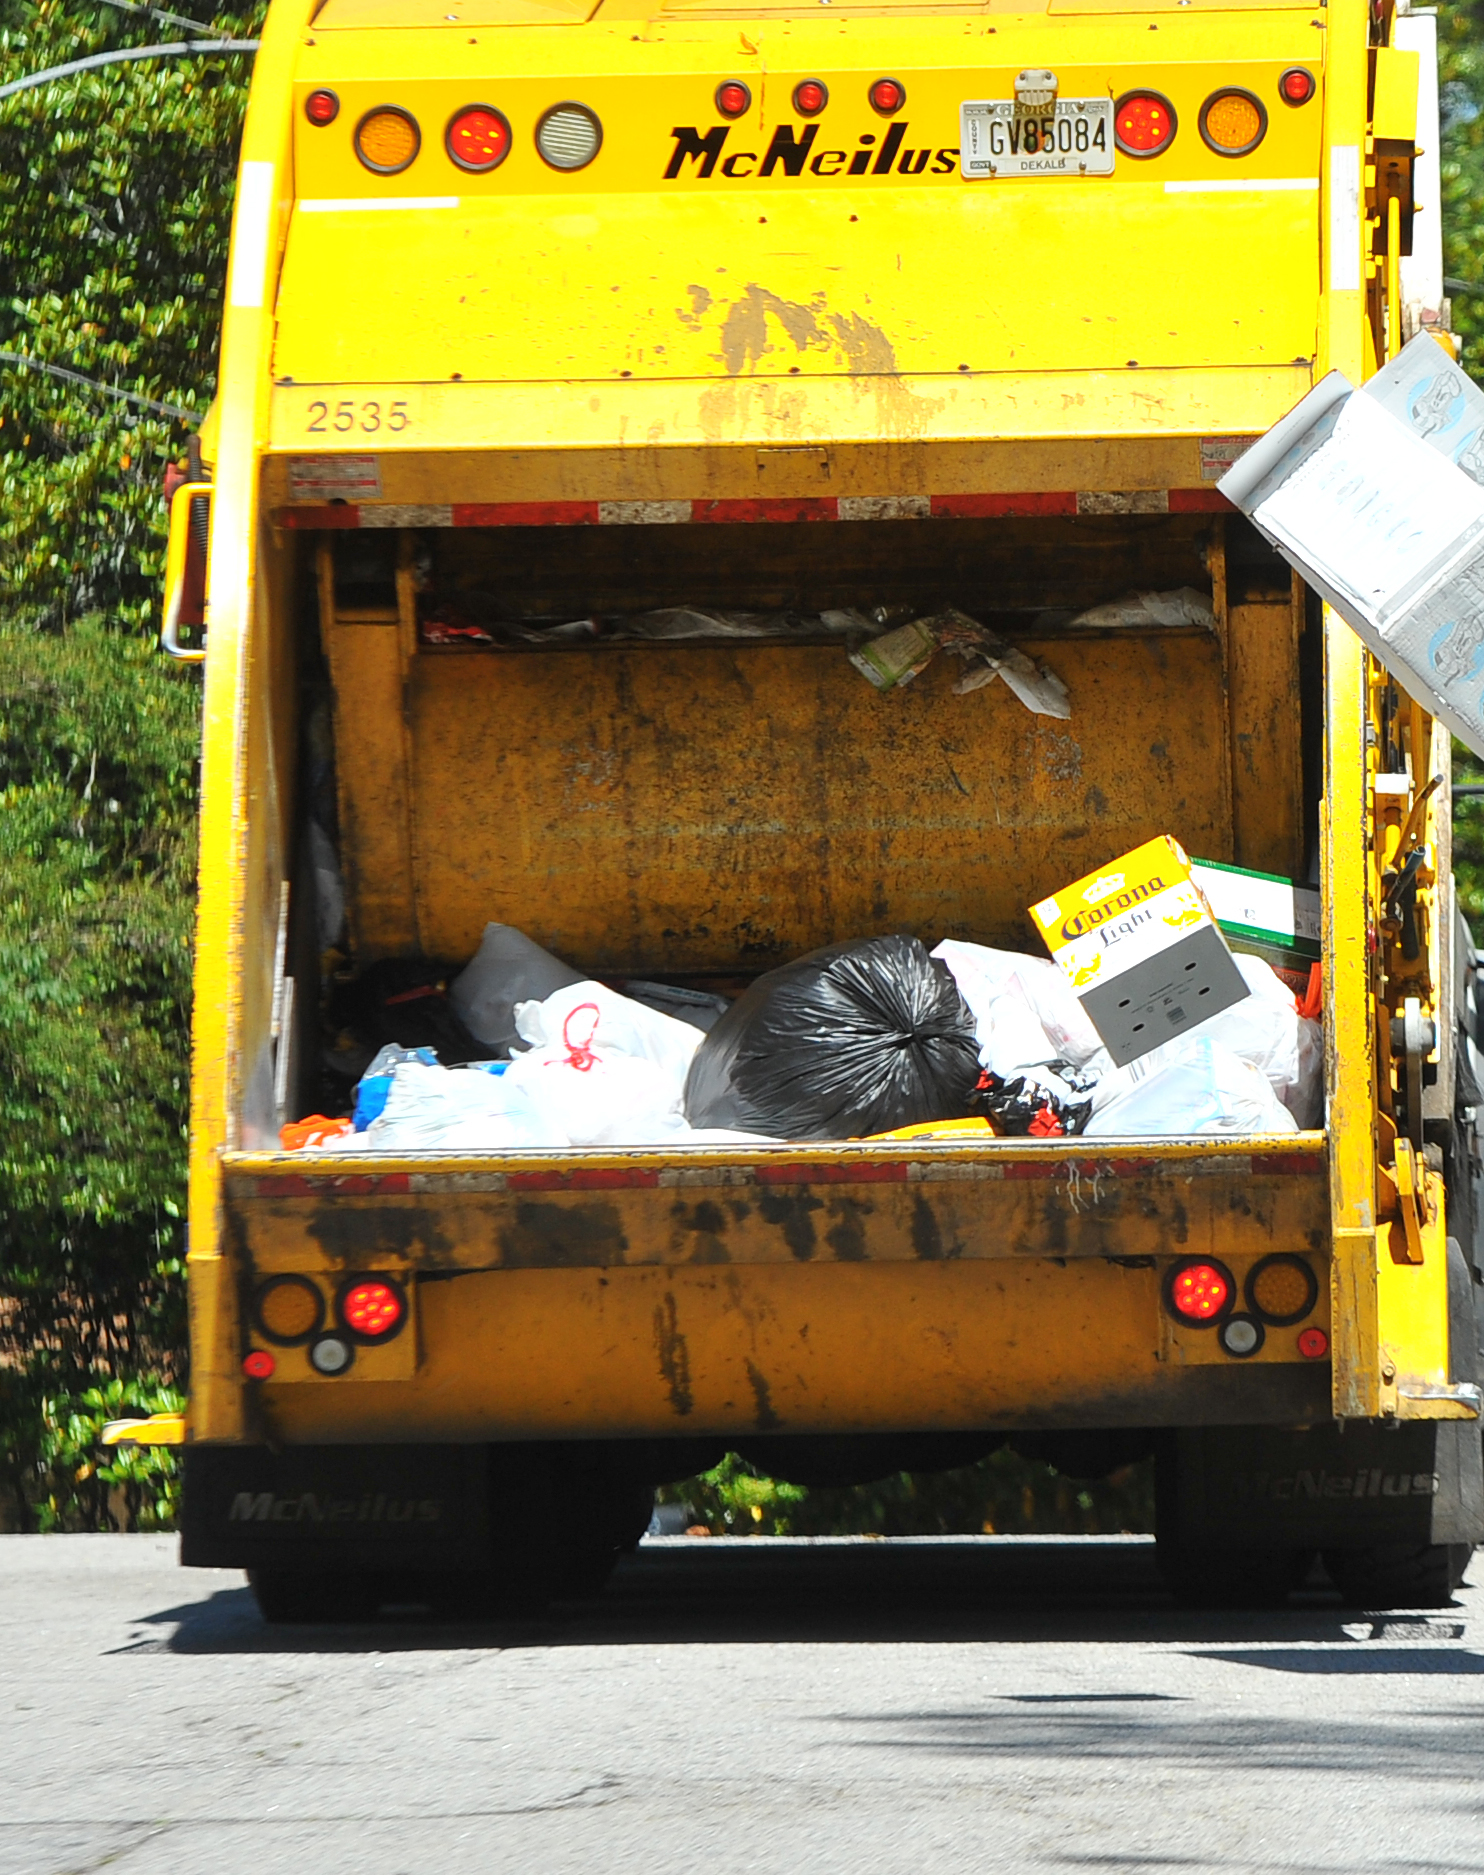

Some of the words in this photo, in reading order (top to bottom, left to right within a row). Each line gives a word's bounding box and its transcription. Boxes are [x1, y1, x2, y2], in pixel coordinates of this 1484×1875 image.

[995, 102, 1080, 116] GEORGIA
[664, 122, 961, 179] McNeilus
[970, 119, 978, 155] COUNTY
[990, 117, 1106, 155] GV85084
[1020, 160, 1067, 170] DEKALB
[306, 400, 409, 433] 2535
[1061, 876, 1166, 941] Corona
[1097, 908, 1153, 948] Light
